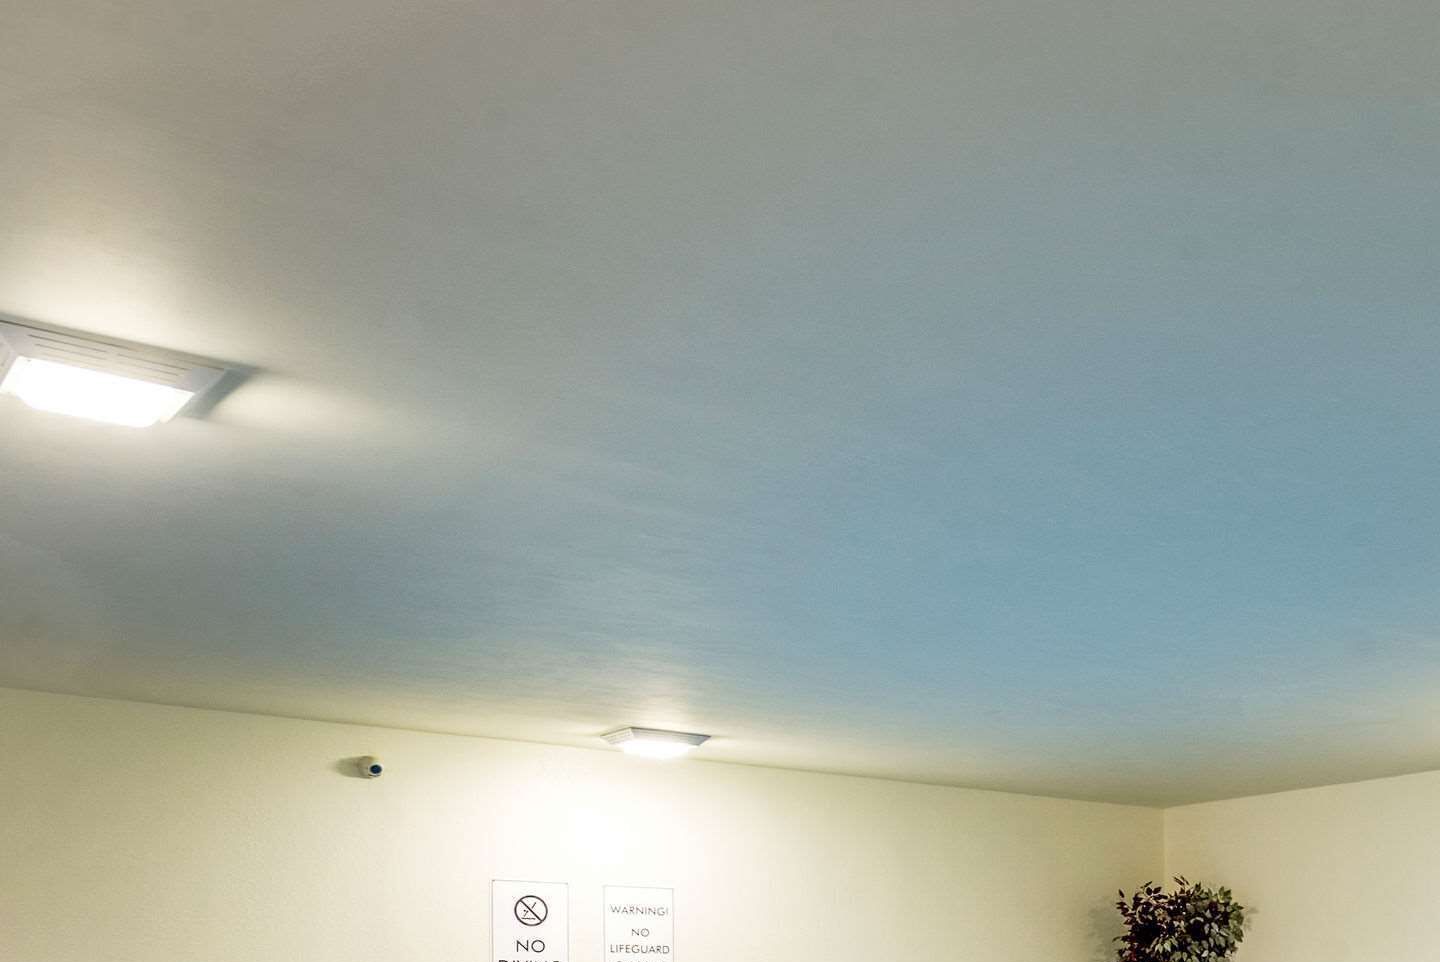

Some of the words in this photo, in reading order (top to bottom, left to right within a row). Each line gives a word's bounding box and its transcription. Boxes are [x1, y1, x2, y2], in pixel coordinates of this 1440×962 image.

[609, 904, 669, 916] WARNING!
[631, 928, 650, 938] NO
[516, 939, 546, 954] NO
[609, 944, 670, 955] LIFEGUARD
